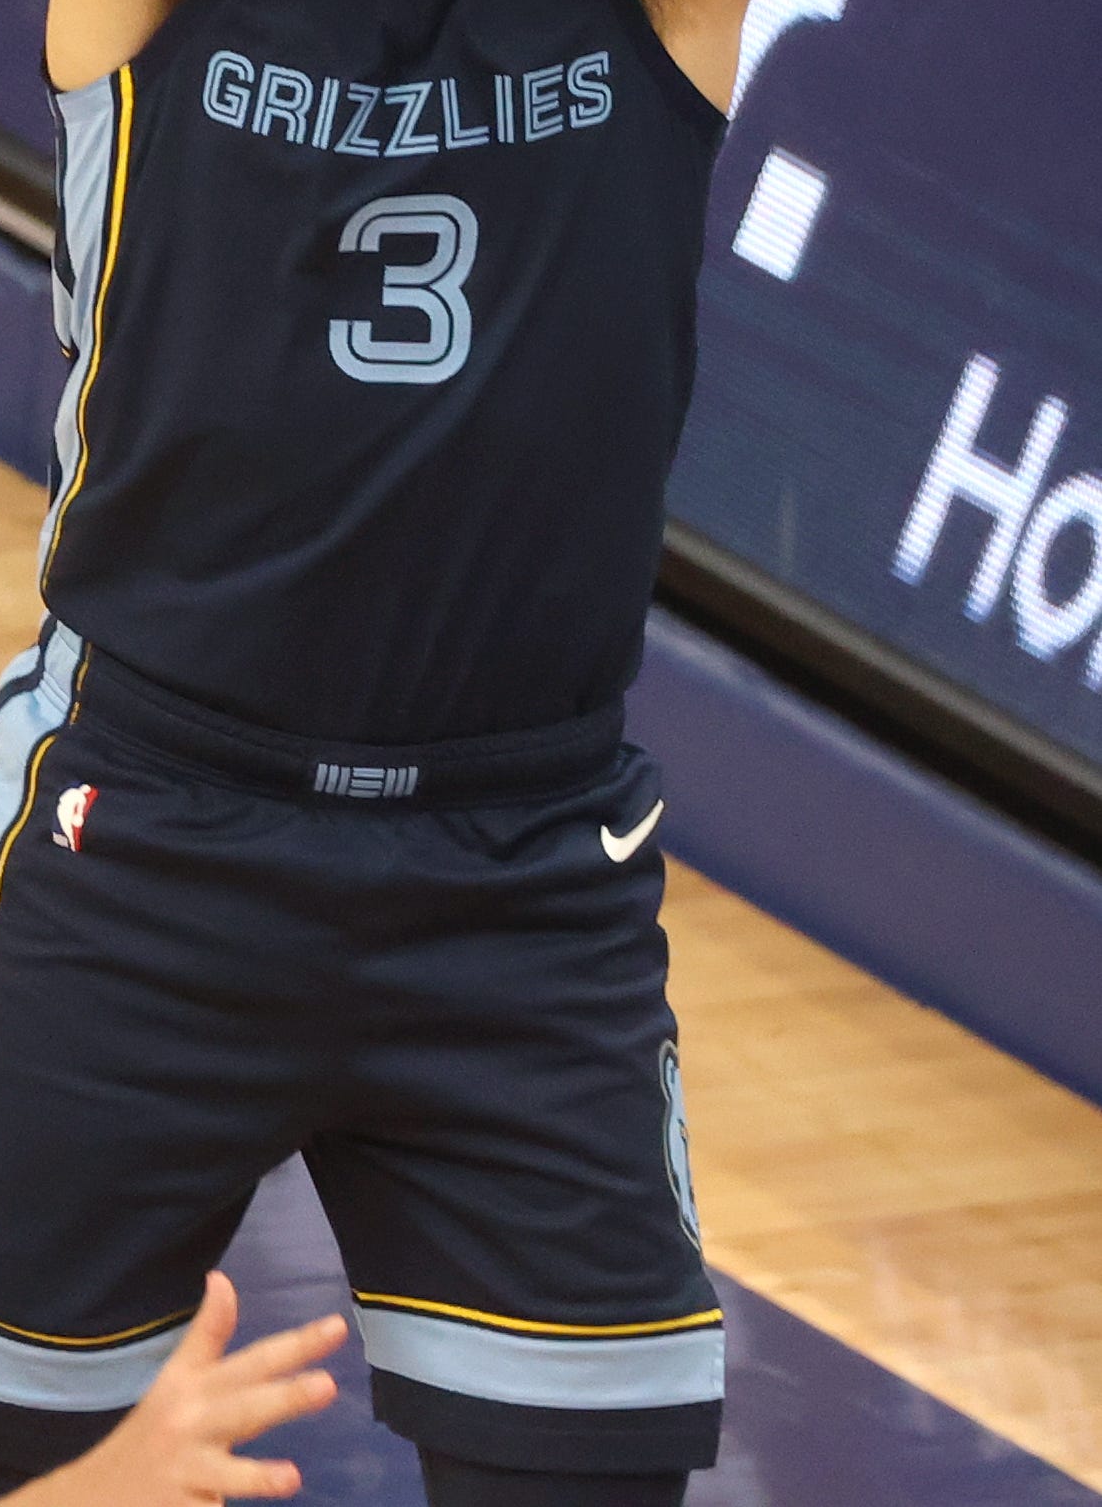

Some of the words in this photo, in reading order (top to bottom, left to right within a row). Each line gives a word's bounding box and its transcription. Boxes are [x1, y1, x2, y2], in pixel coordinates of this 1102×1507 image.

[202, 49, 614, 159] GRIZZLIES
[328, 193, 479, 385] 3
[891, 351, 1102, 692] Ho
